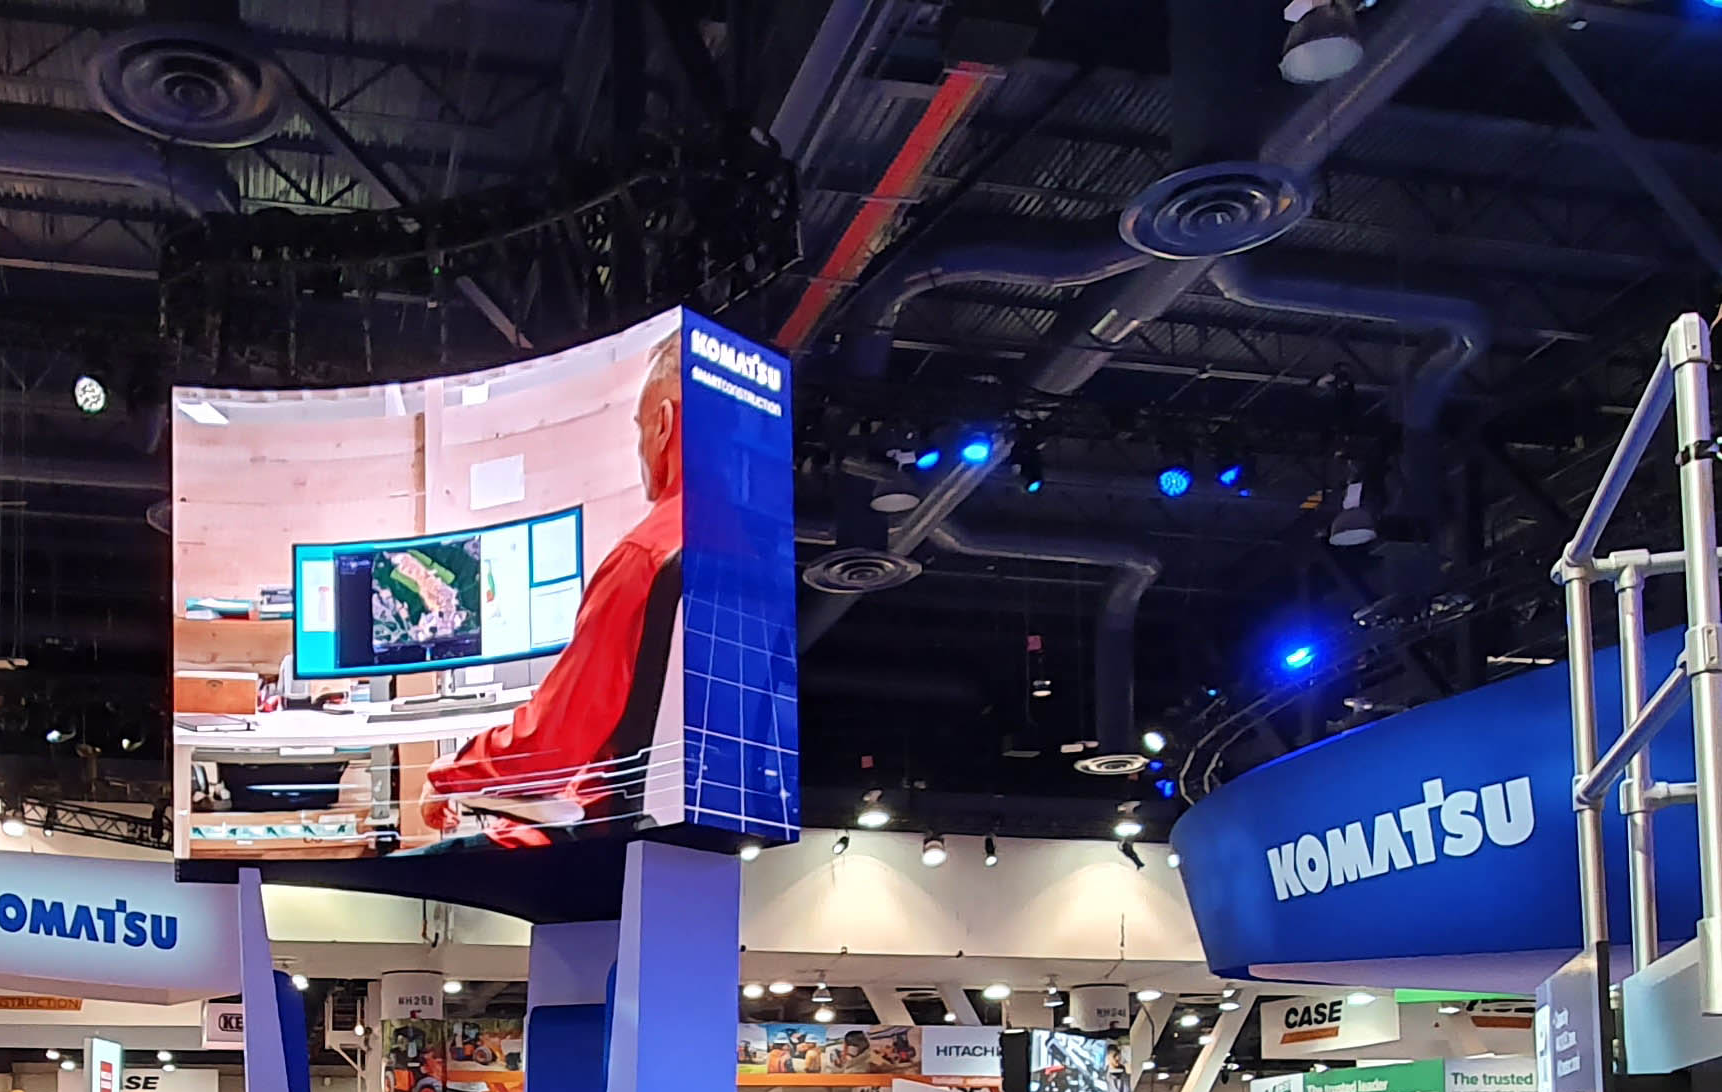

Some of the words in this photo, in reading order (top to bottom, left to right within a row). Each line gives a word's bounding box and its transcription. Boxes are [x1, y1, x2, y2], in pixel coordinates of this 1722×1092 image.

[691, 329, 781, 392] KOMATSU
[1266, 776, 1535, 901] KOMATSU
[222, 1016, 243, 1030] KE
[1284, 1000, 1342, 1029] CASE
[122, 1076, 159, 1090] SE
[1451, 1071, 1479, 1086] The
[1482, 1072, 1534, 1086] trusted
